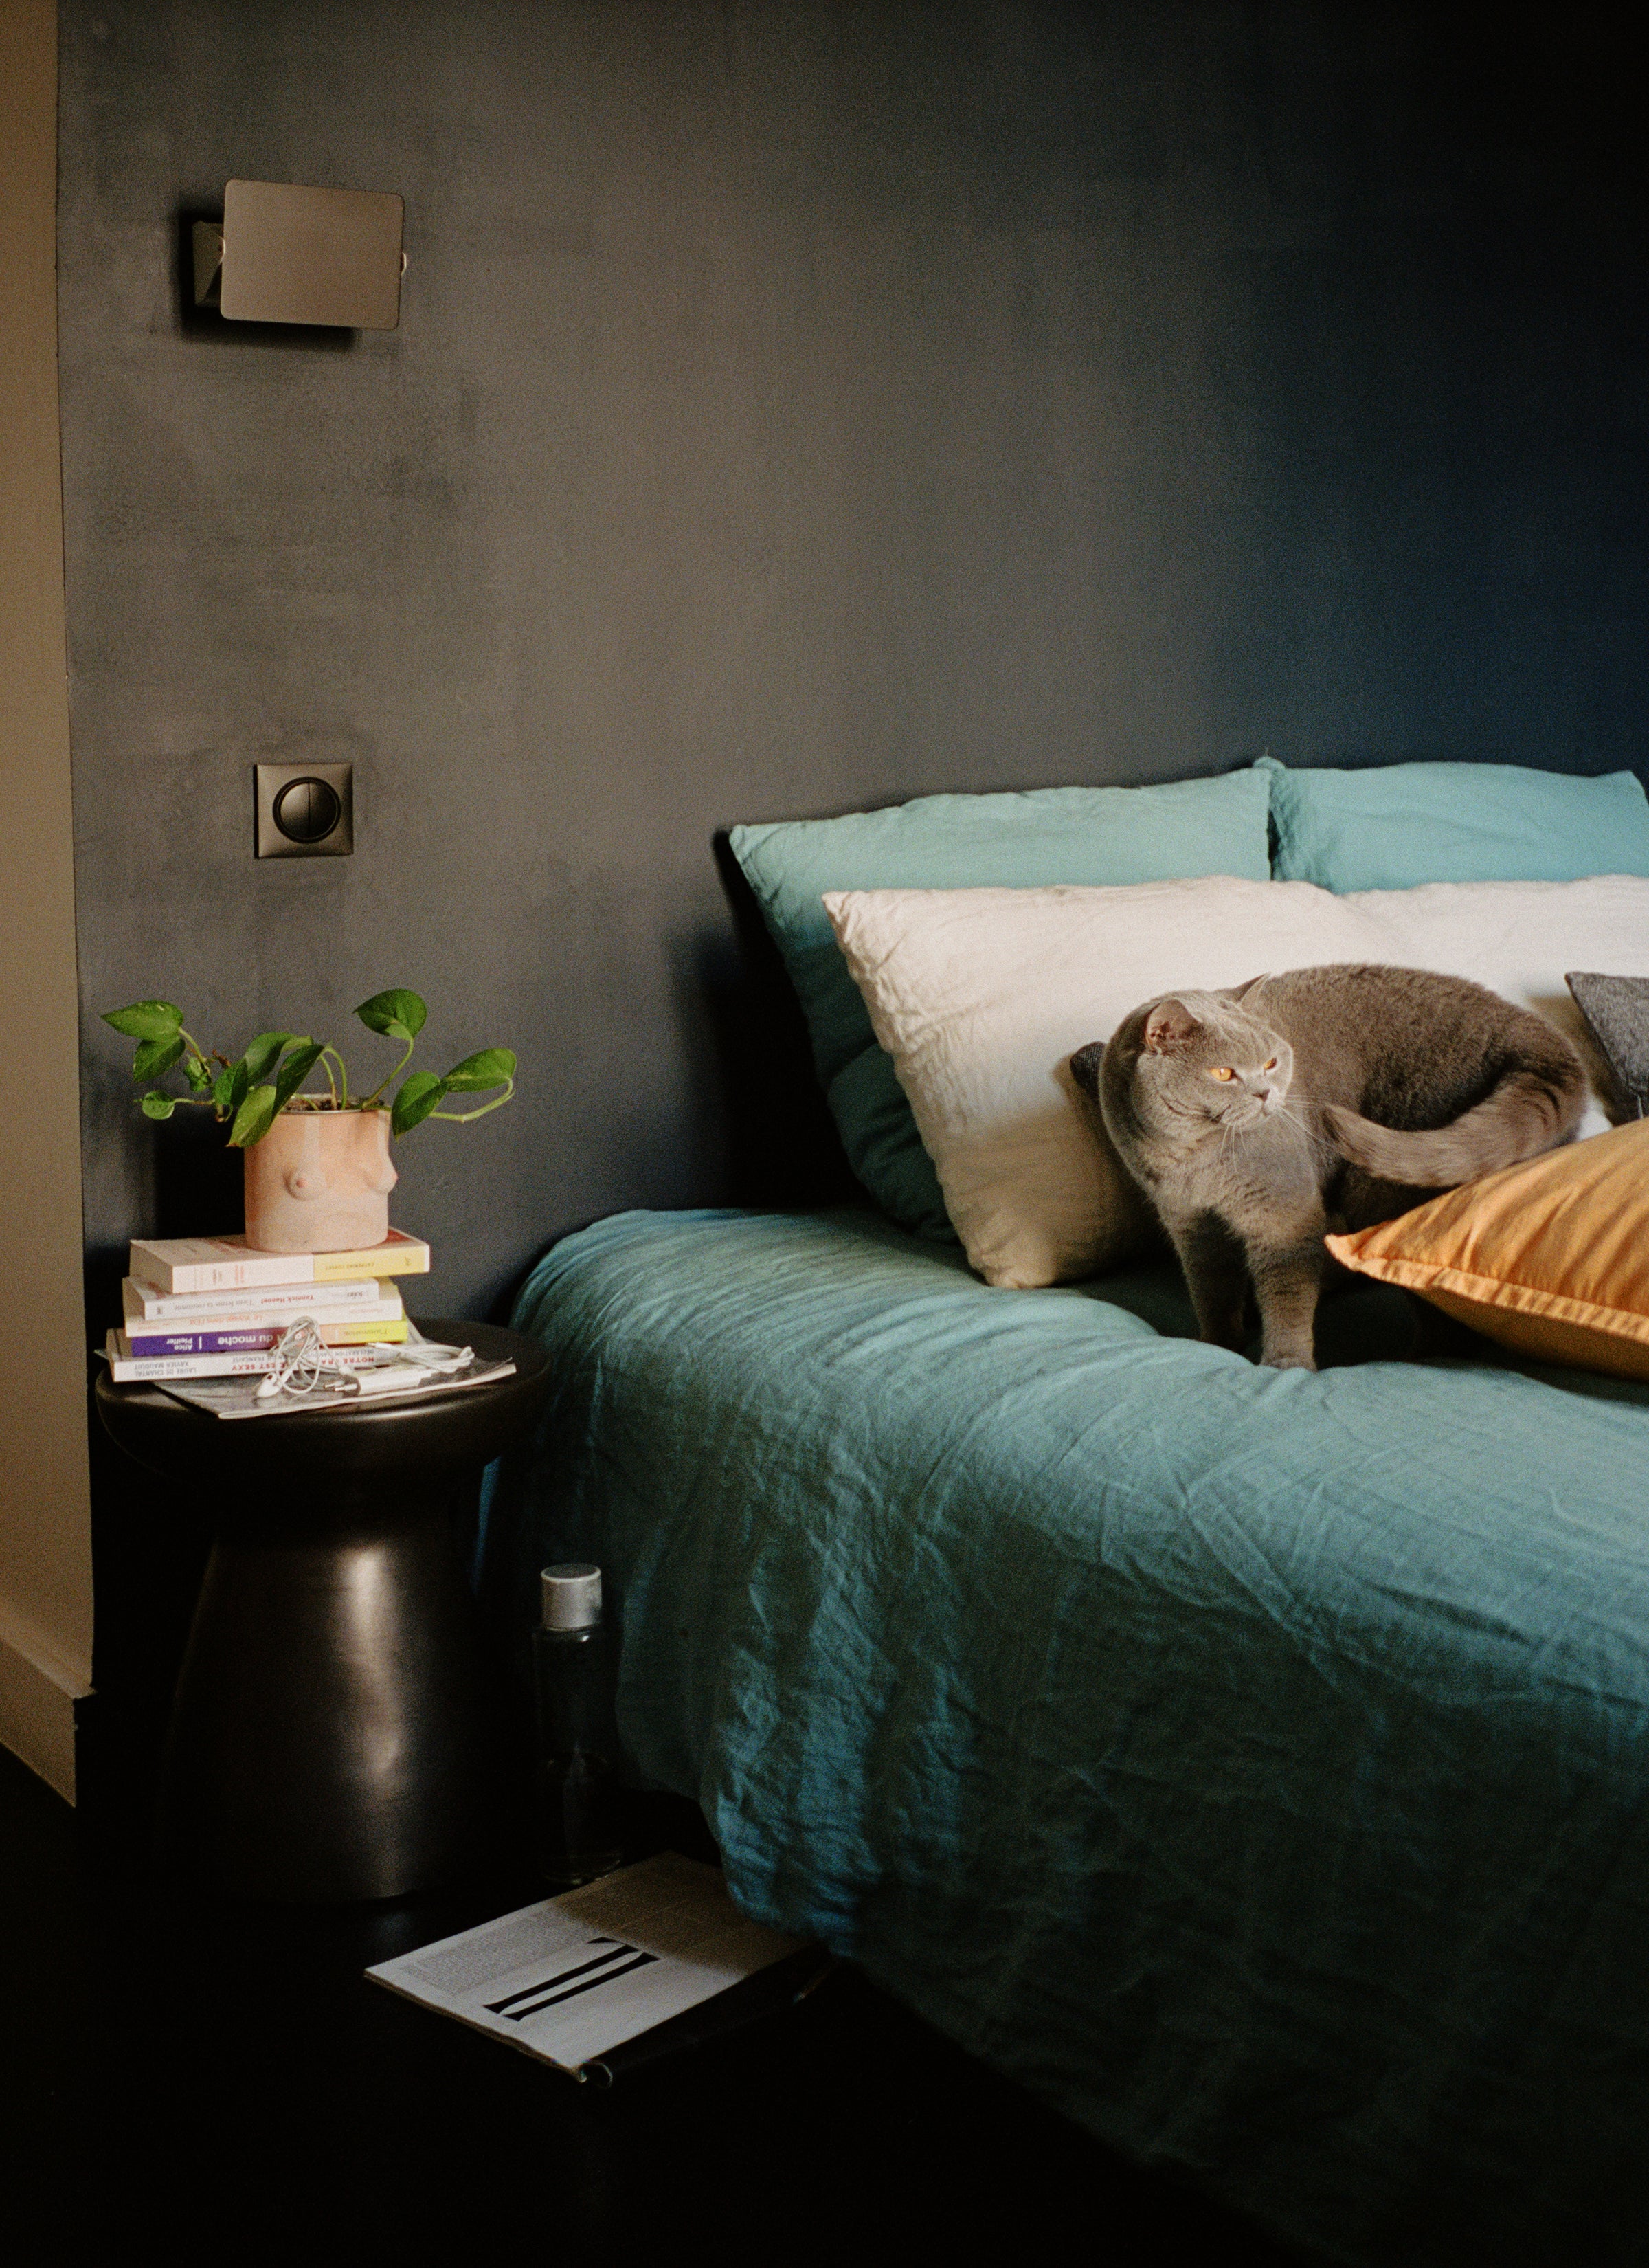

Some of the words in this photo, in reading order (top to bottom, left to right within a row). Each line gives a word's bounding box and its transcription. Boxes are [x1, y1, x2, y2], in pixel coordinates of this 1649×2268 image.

[287, 1294, 314, 1303] Yannick
[217, 1335, 256, 1346] moche
[259, 1335, 273, 1343] du
[232, 1364, 255, 1372] SEXY
